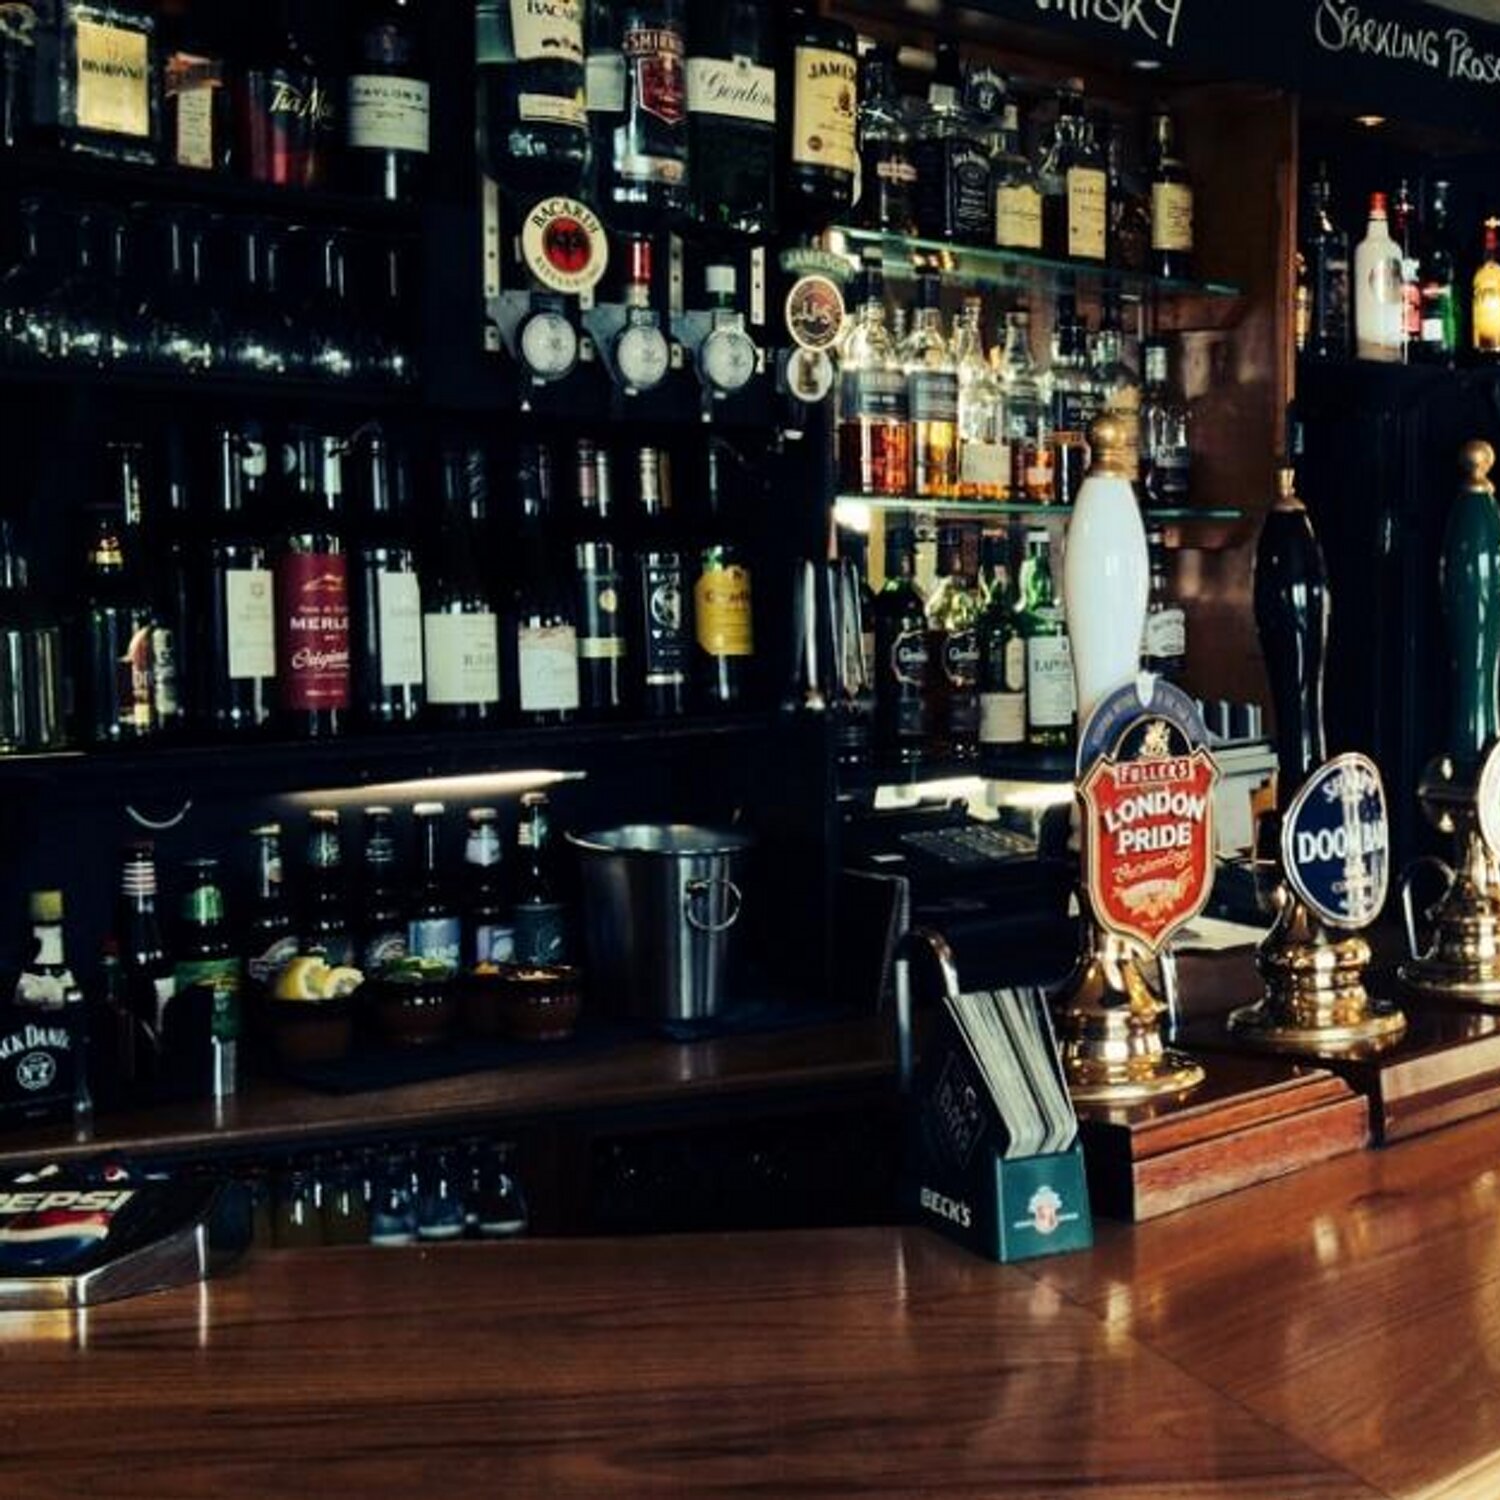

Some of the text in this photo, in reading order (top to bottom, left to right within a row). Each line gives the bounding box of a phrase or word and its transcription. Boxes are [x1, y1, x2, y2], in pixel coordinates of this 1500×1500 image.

[1315, 0, 1439, 68] SPARKLING
[700, 72, 773, 107] Gordon
[532, 201, 599, 234] BACARDI
[1105, 788, 1205, 832] LONDON
[1116, 821, 1193, 855] PRIDE
[0, 1189, 136, 1213] EPSI
[920, 1186, 972, 1229] BECK'S
